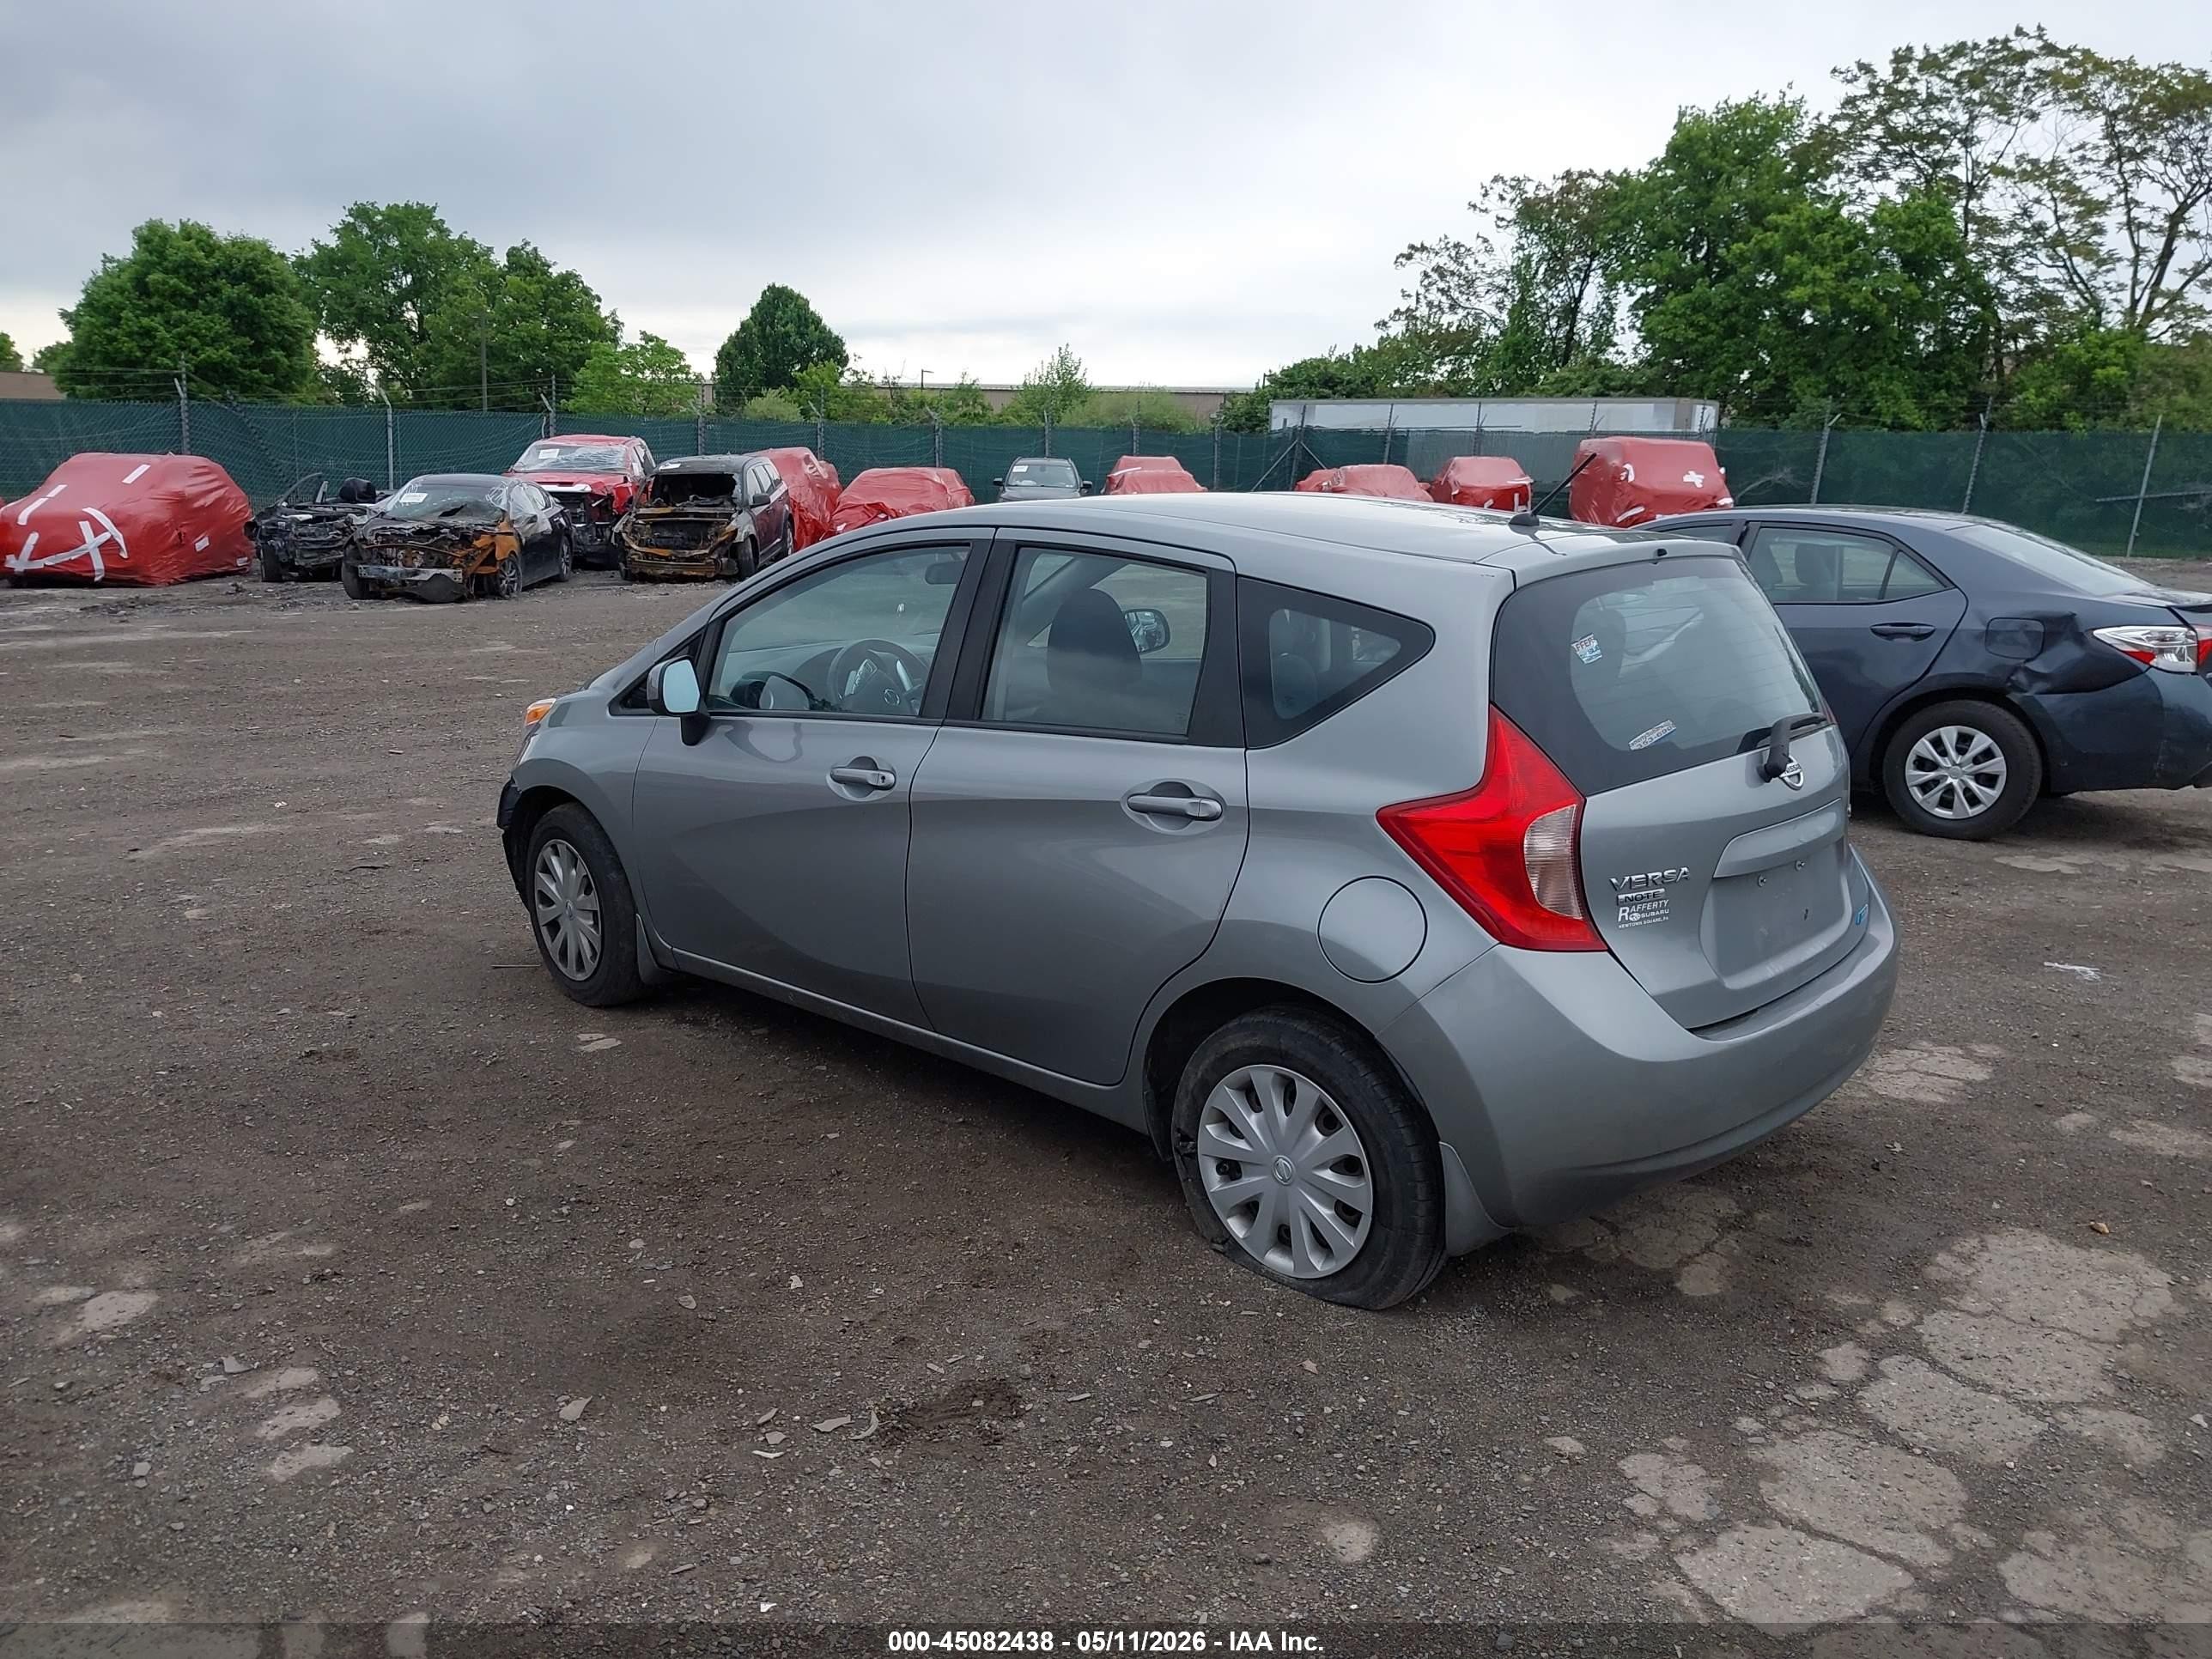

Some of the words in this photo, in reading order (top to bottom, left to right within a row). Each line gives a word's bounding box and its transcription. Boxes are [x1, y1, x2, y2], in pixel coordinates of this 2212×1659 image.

[1609, 866, 1690, 891] VERSA
[1624, 890, 1662, 902] NOTE
[1618, 899, 1669, 922] RAFFERTY
[1640, 908, 1669, 919] SUBARU
[1618, 920, 1643, 929] NEWTOWN
